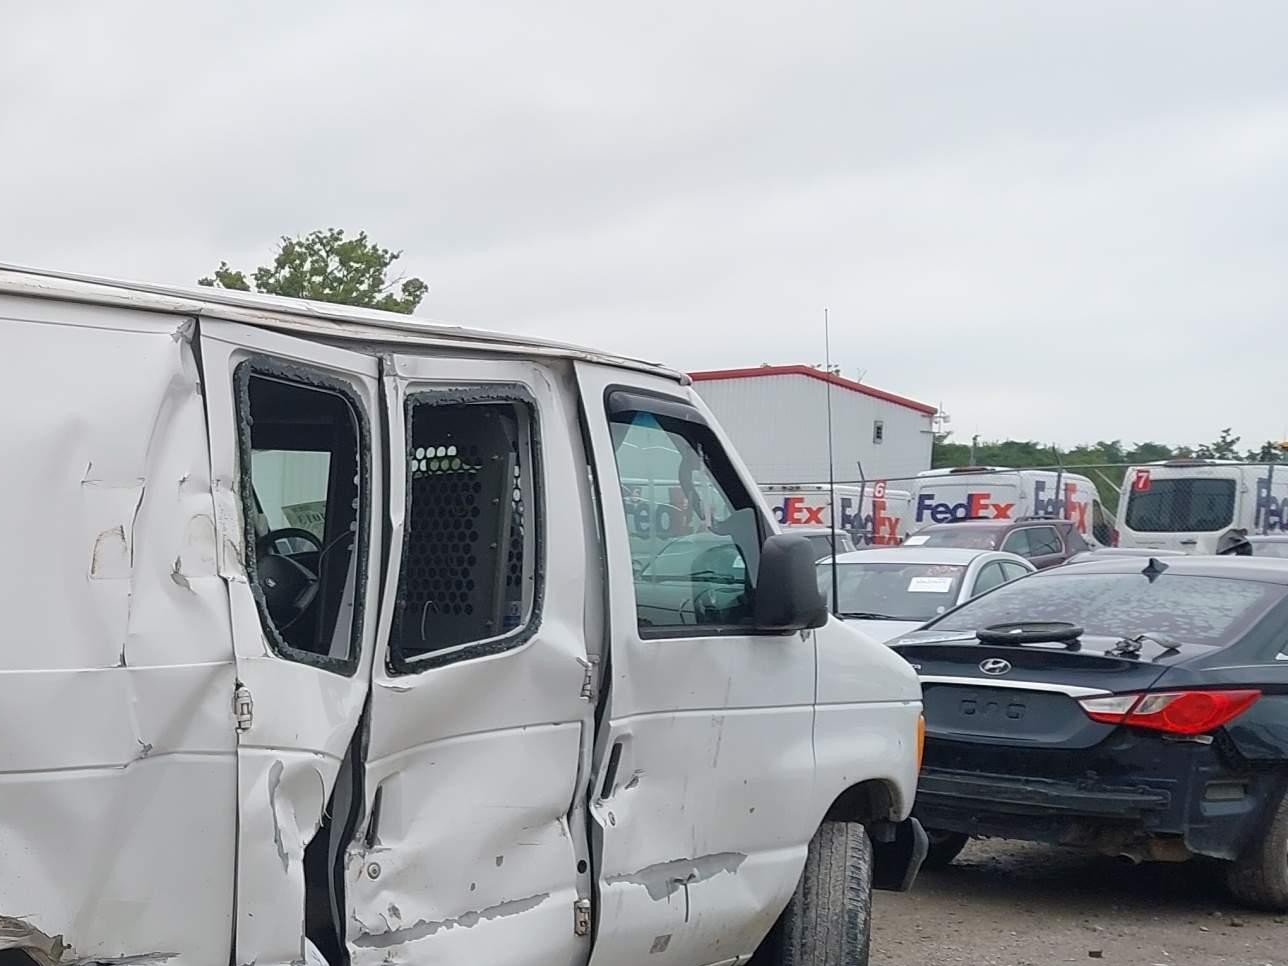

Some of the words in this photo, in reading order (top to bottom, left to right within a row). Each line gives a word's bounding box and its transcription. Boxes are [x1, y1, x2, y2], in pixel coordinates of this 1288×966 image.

[874, 482, 885, 498] 6
[1137, 471, 1149, 489] 7
[772, 497, 826, 525] dEx
[840, 497, 901, 546] FedEx
[915, 493, 1015, 523] FedEx
